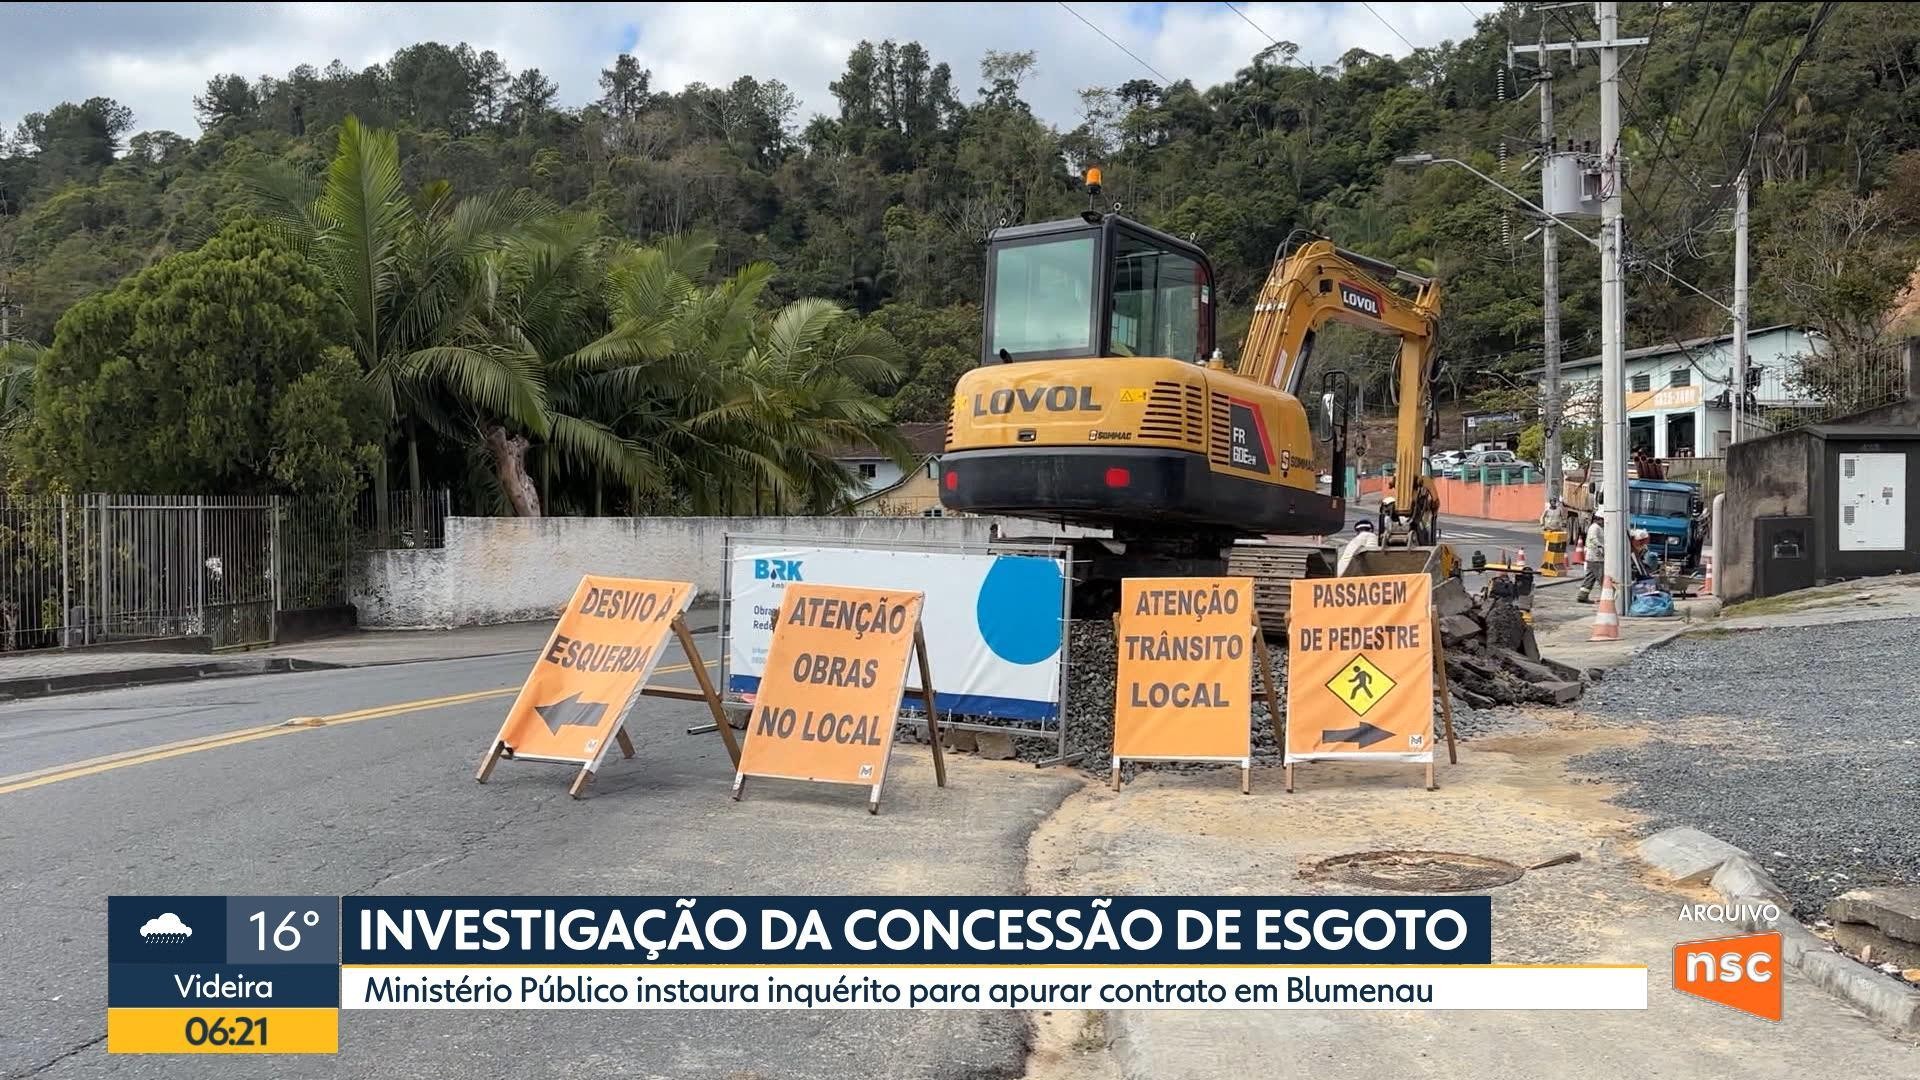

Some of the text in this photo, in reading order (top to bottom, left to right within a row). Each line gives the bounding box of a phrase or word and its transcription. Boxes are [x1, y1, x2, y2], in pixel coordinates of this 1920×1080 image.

[1342, 290, 1378, 314] LOVOL
[974, 386, 1102, 416] LOVOL
[1233, 427, 1246, 445] FR
[755, 559, 804, 582] BRK
[580, 587, 674, 622] DESVIO À
[1136, 583, 1239, 622] ATENÇÃO
[1313, 580, 1408, 608] PASSAGEM
[788, 597, 906, 640] ATENÇÃO
[1125, 630, 1243, 661] TRÂNSITO
[1300, 624, 1420, 651] DE PEDESTRE
[545, 634, 652, 673] ESQUERDA
[793, 653, 879, 688] OBRAS
[1131, 682, 1230, 708] LOCAL
[757, 705, 882, 746] NO LOCAL
